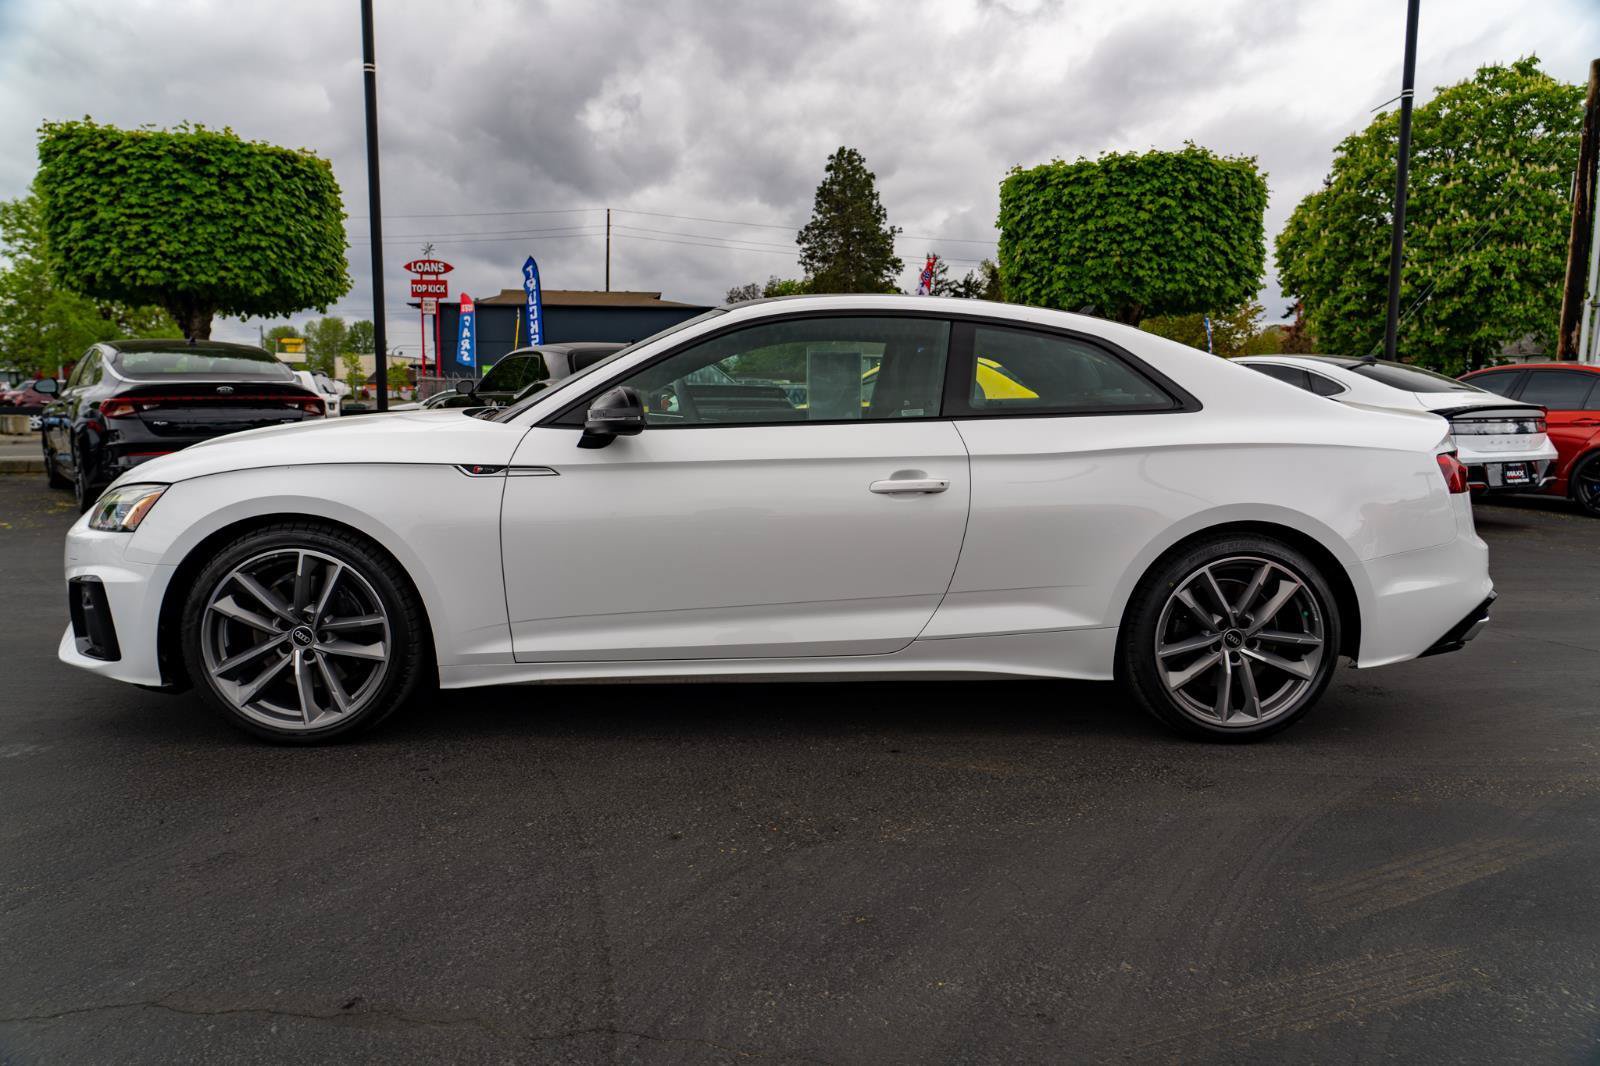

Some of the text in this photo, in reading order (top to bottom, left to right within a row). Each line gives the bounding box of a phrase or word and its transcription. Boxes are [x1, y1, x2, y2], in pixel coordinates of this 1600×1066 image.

[411, 262, 445, 273] LOANS
[411, 284, 445, 293] TOP KICK
